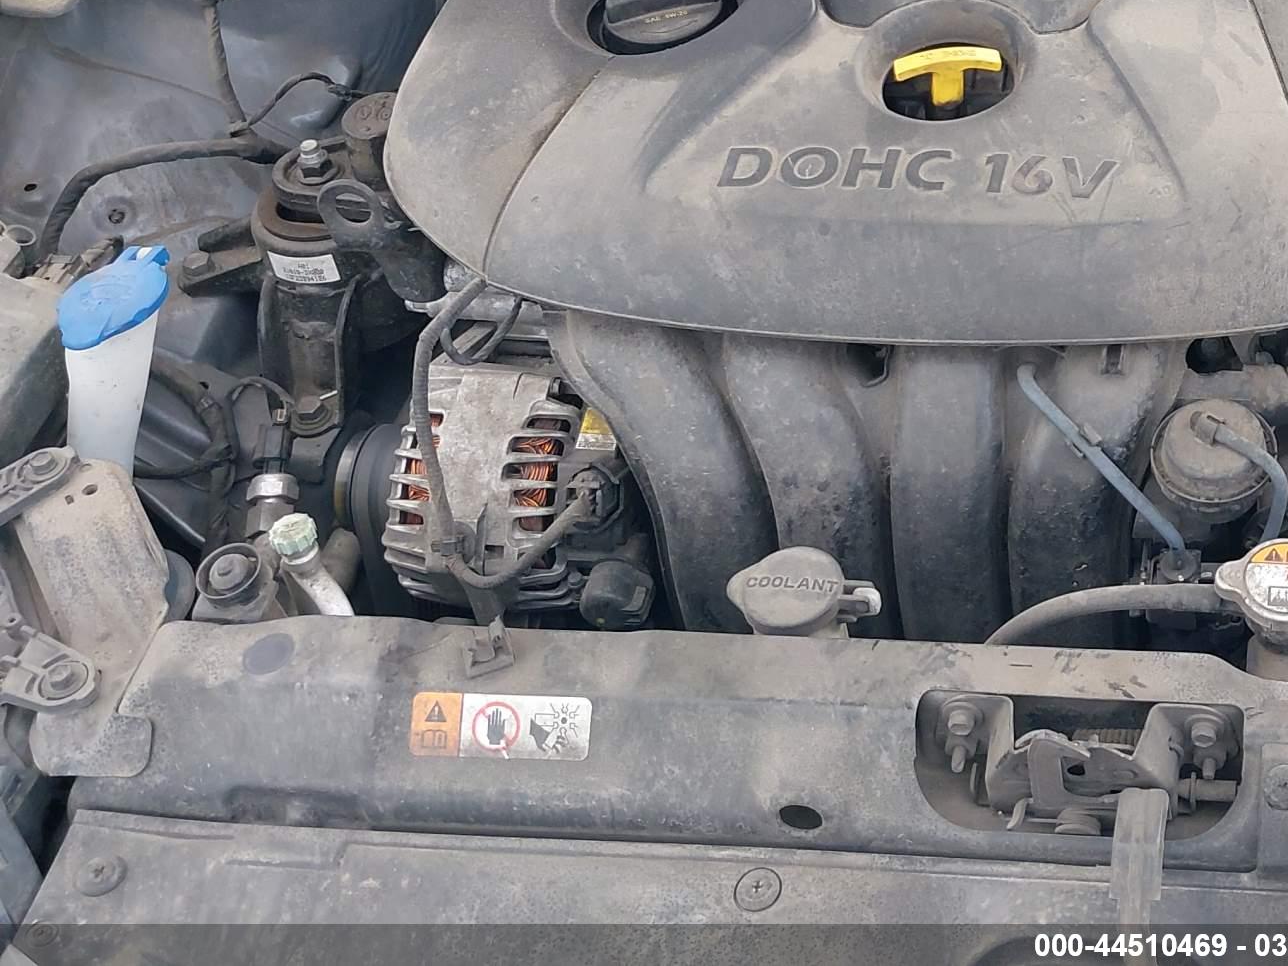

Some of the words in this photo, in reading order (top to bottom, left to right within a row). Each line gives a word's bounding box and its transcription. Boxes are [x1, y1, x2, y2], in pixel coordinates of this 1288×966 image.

[716, 145, 953, 191] DOHC
[985, 152, 1120, 199] 16V
[745, 576, 839, 593] COOLANT
